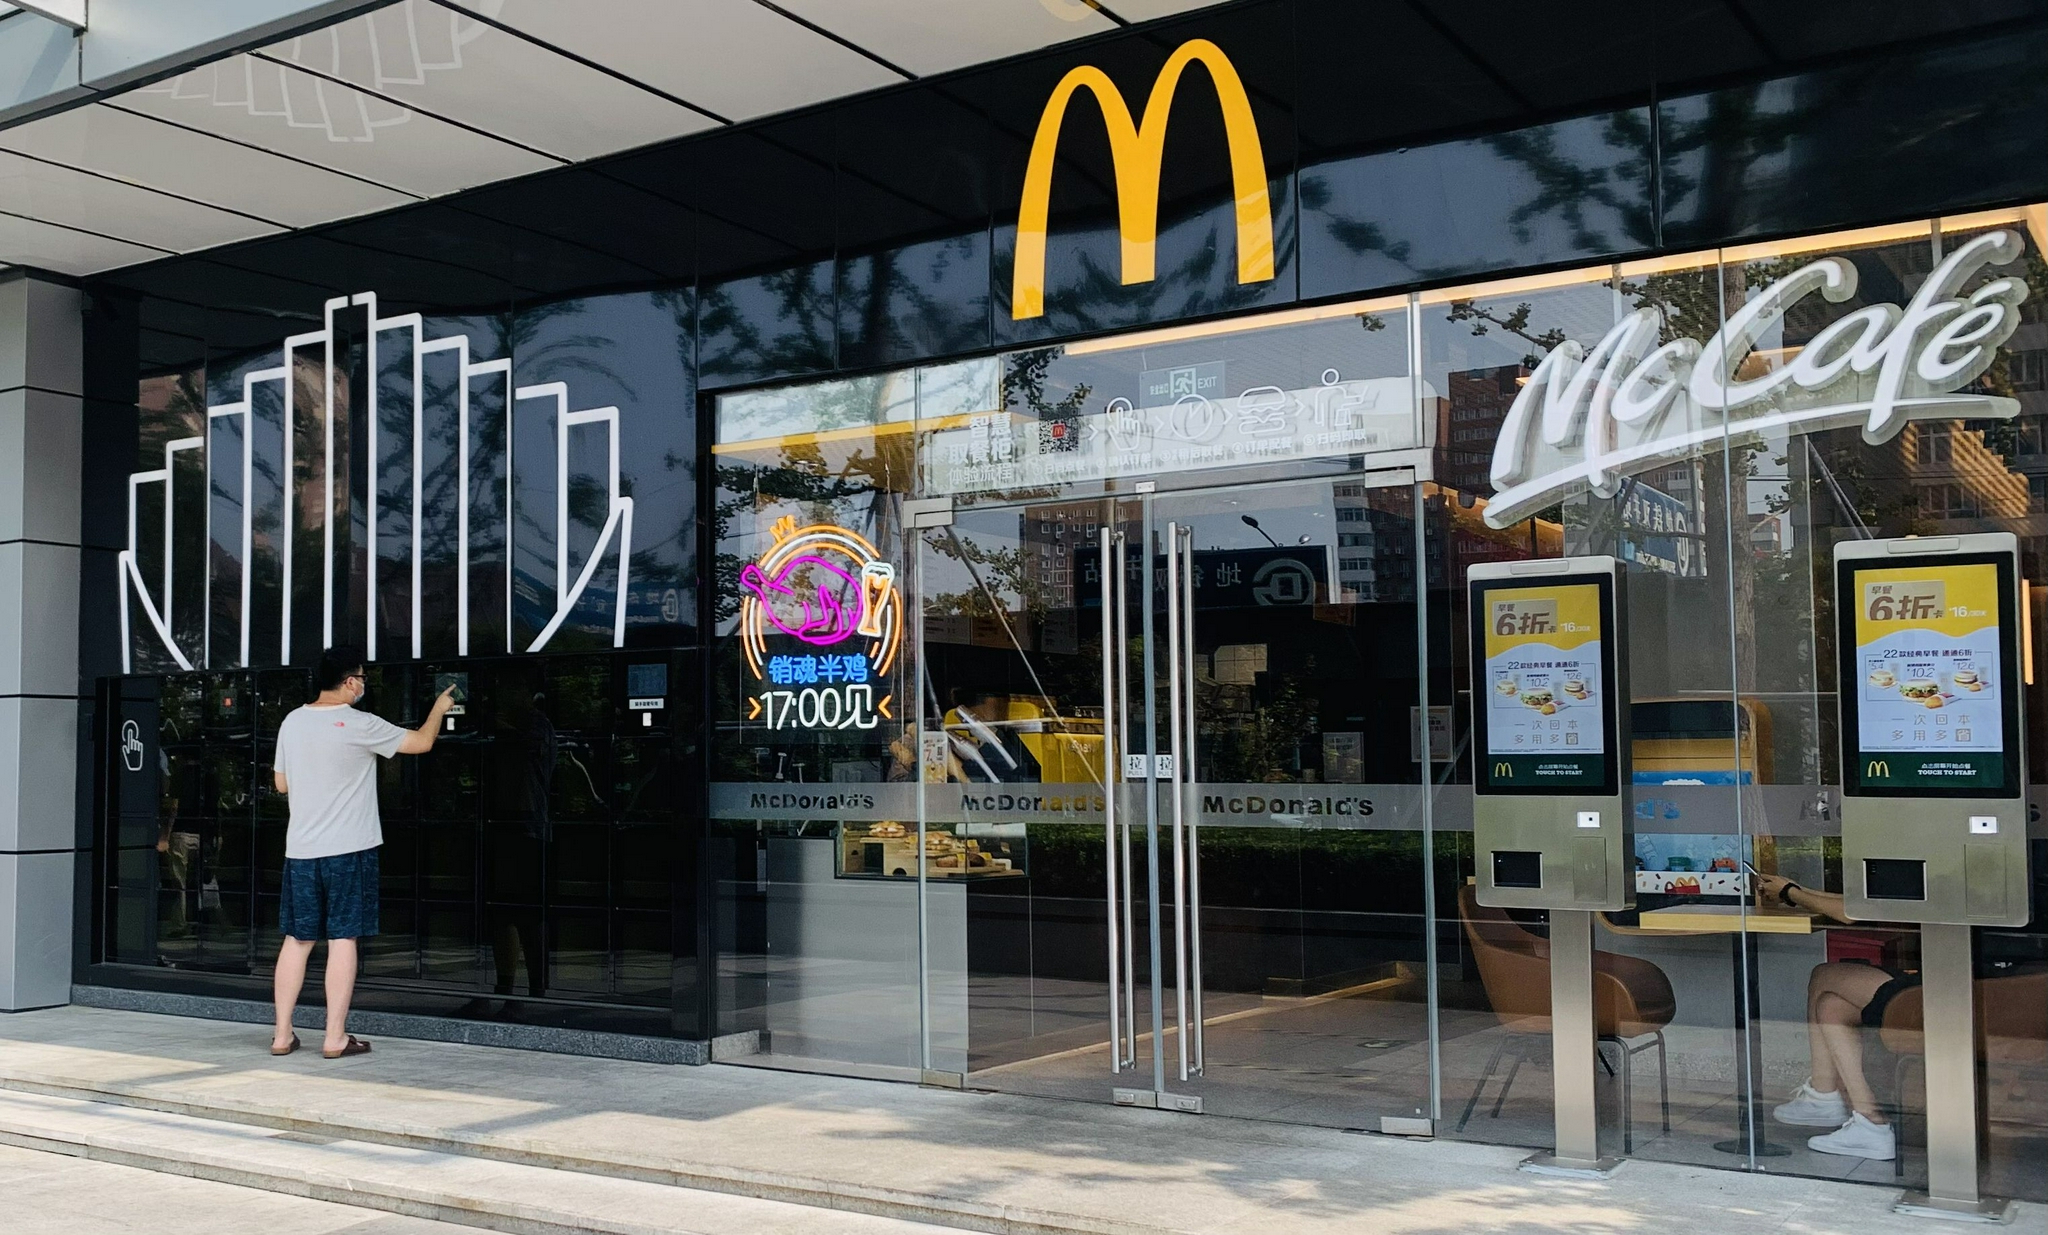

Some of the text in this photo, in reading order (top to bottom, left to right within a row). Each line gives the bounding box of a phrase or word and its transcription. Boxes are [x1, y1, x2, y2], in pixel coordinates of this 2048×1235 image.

[1490, 230, 2030, 490] McCafé
[1198, 376, 1217, 389] EXIT
[948, 462, 1013, 483] 体验流程
[768, 653, 868, 684] 销魂半鸡
[760, 684, 878, 730] 17:00见
[1514, 720, 1578, 730] 一次回本
[1891, 714, 1970, 725] 一次回本
[1891, 729, 1971, 742] 多用多省
[1129, 756, 1143, 770] 拉
[1159, 756, 1173, 770] 拉
[749, 793, 875, 810] McDonald's
[960, 794, 1107, 812] McDonald's
[1202, 795, 1375, 816] McDonald's
